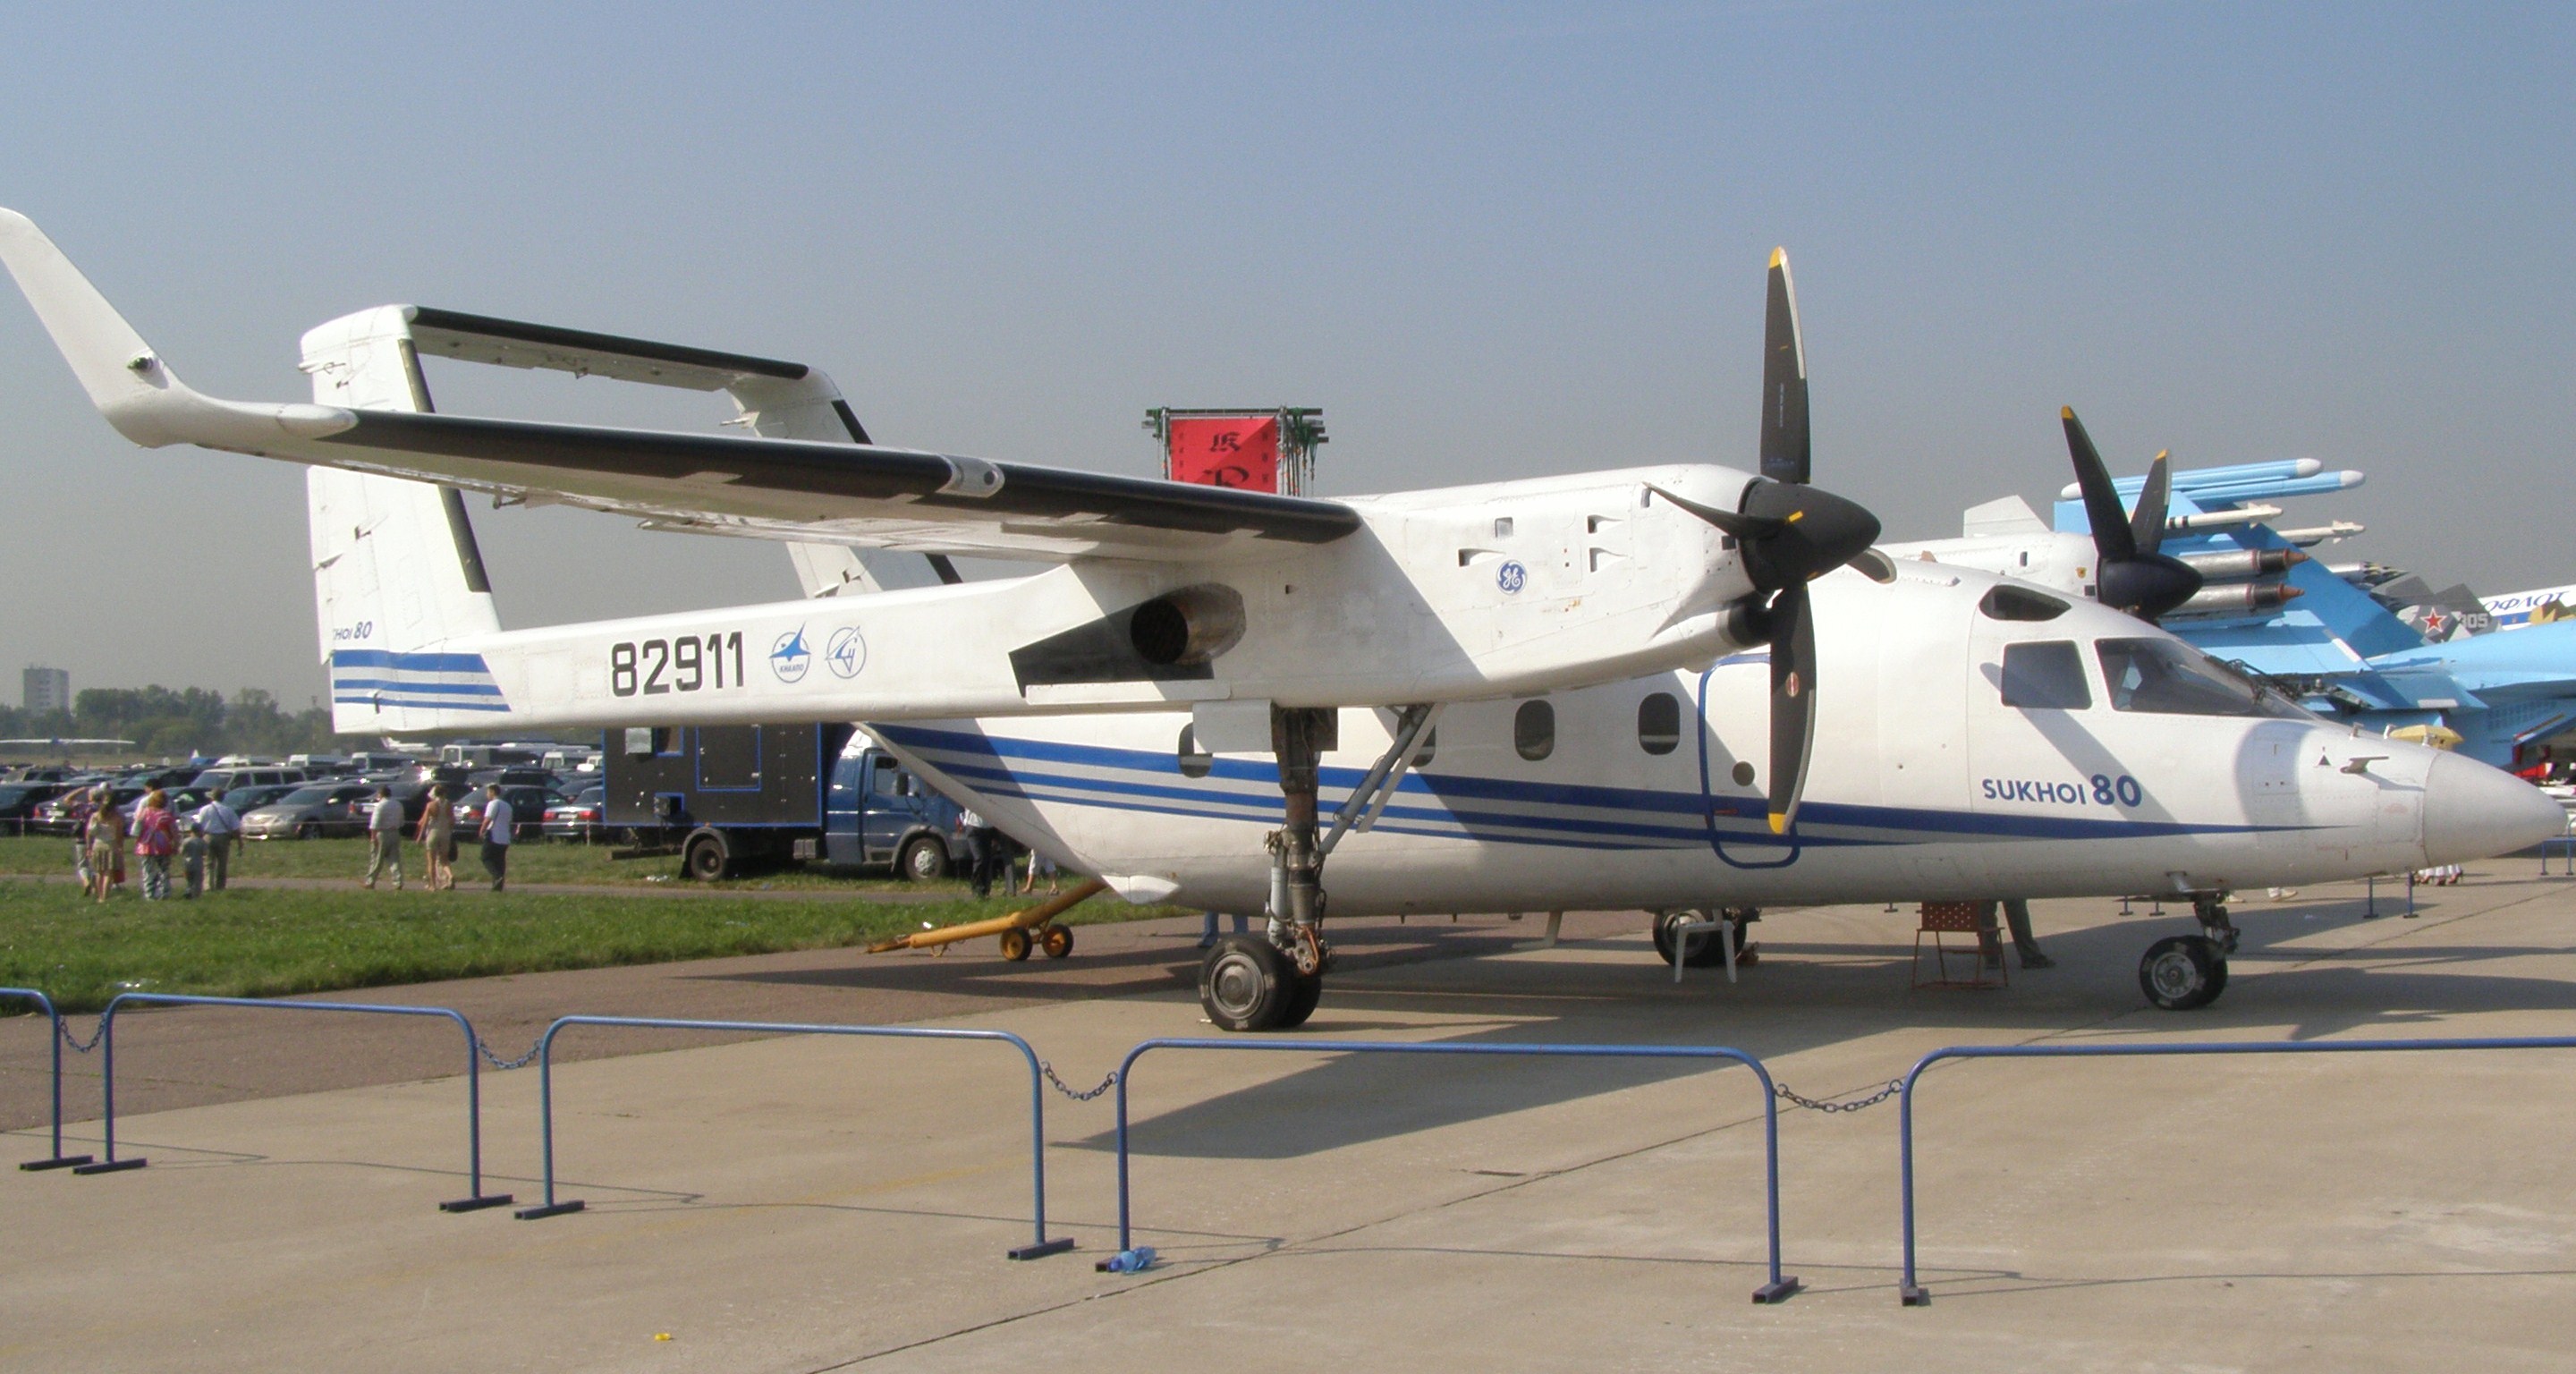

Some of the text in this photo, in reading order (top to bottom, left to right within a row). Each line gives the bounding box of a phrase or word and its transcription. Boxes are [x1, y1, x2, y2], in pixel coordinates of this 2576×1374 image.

[353, 621, 372, 639] 80
[2459, 613, 2489, 629] 305
[611, 632, 744, 697] 82911
[1982, 774, 2142, 808] SUKHOI 80
